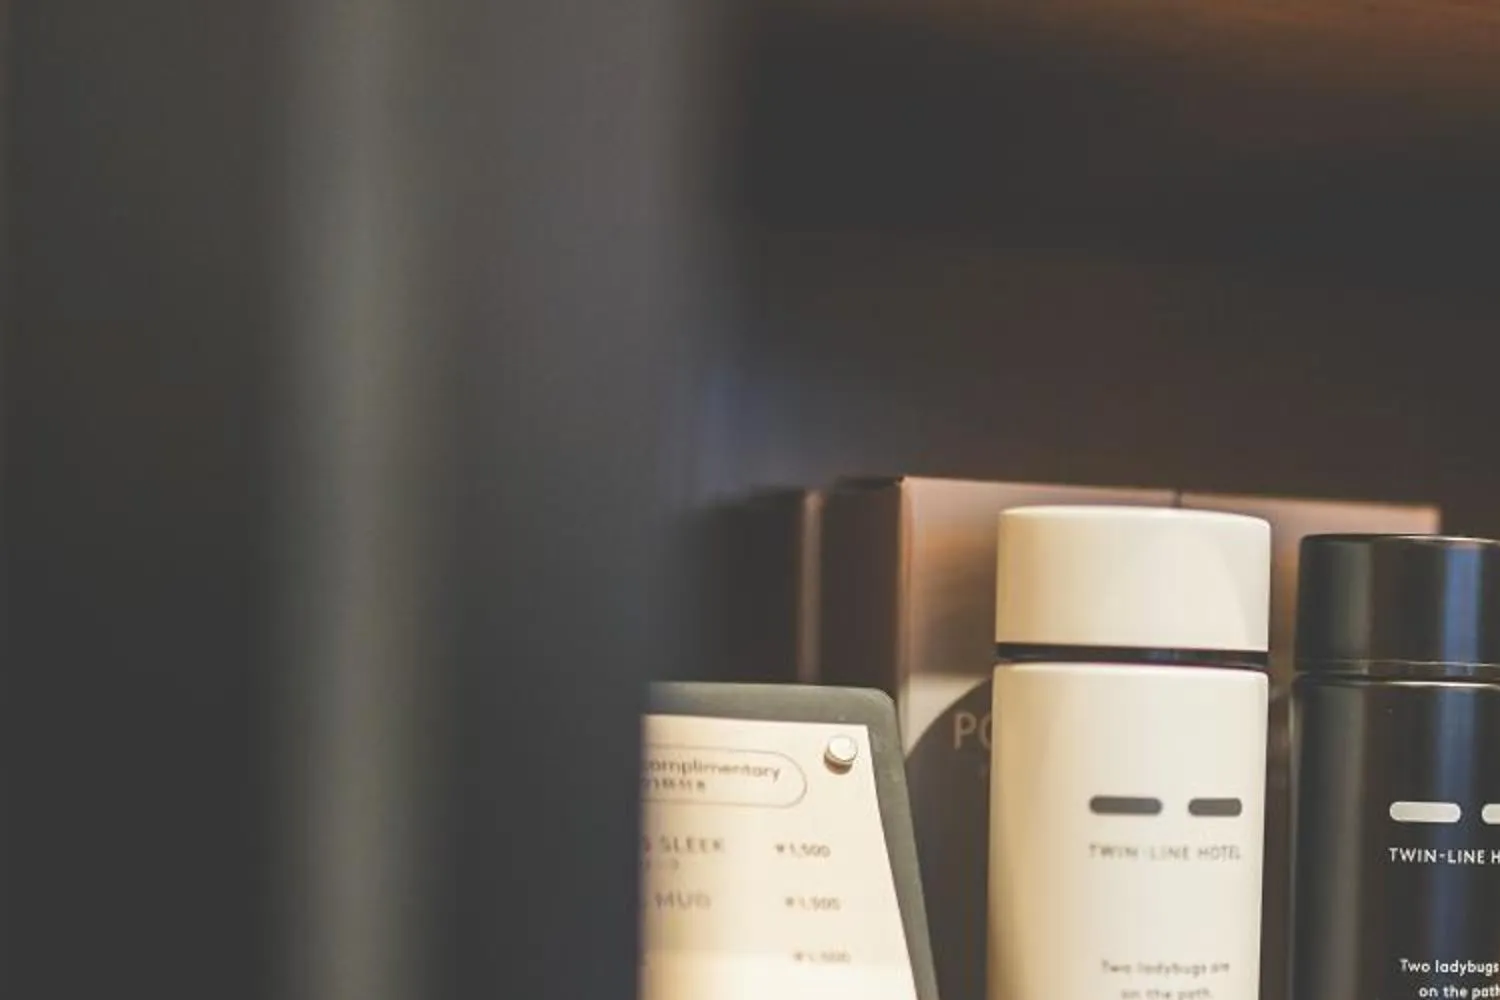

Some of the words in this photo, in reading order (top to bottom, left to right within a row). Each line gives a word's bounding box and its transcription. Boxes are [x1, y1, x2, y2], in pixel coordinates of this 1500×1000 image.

[1388, 847, 1485, 865] TWIN-LINE
[1399, 958, 1431, 973] Two
[1435, 960, 1499, 977] ladybugs
[1418, 987, 1439, 998] on
[1443, 985, 1468, 999] the
